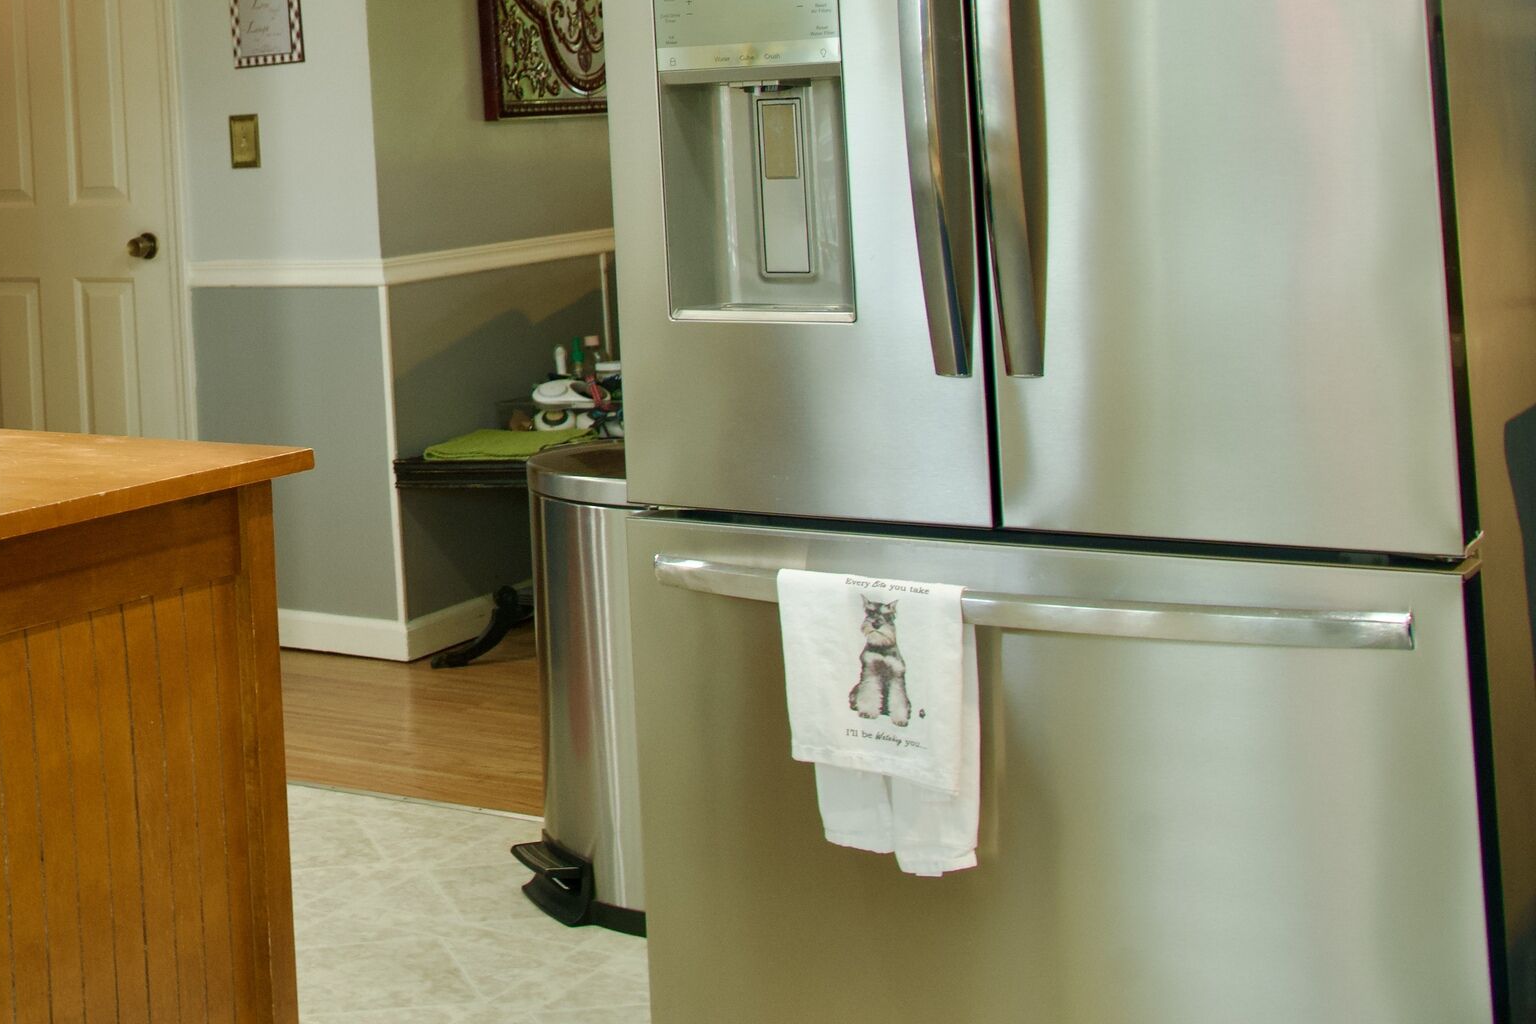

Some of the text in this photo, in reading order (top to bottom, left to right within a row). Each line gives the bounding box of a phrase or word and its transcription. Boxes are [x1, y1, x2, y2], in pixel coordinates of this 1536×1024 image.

[845, 577, 871, 588] Every
[889, 583, 906, 592] you
[909, 586, 930, 595] take
[861, 731, 873, 739] be
